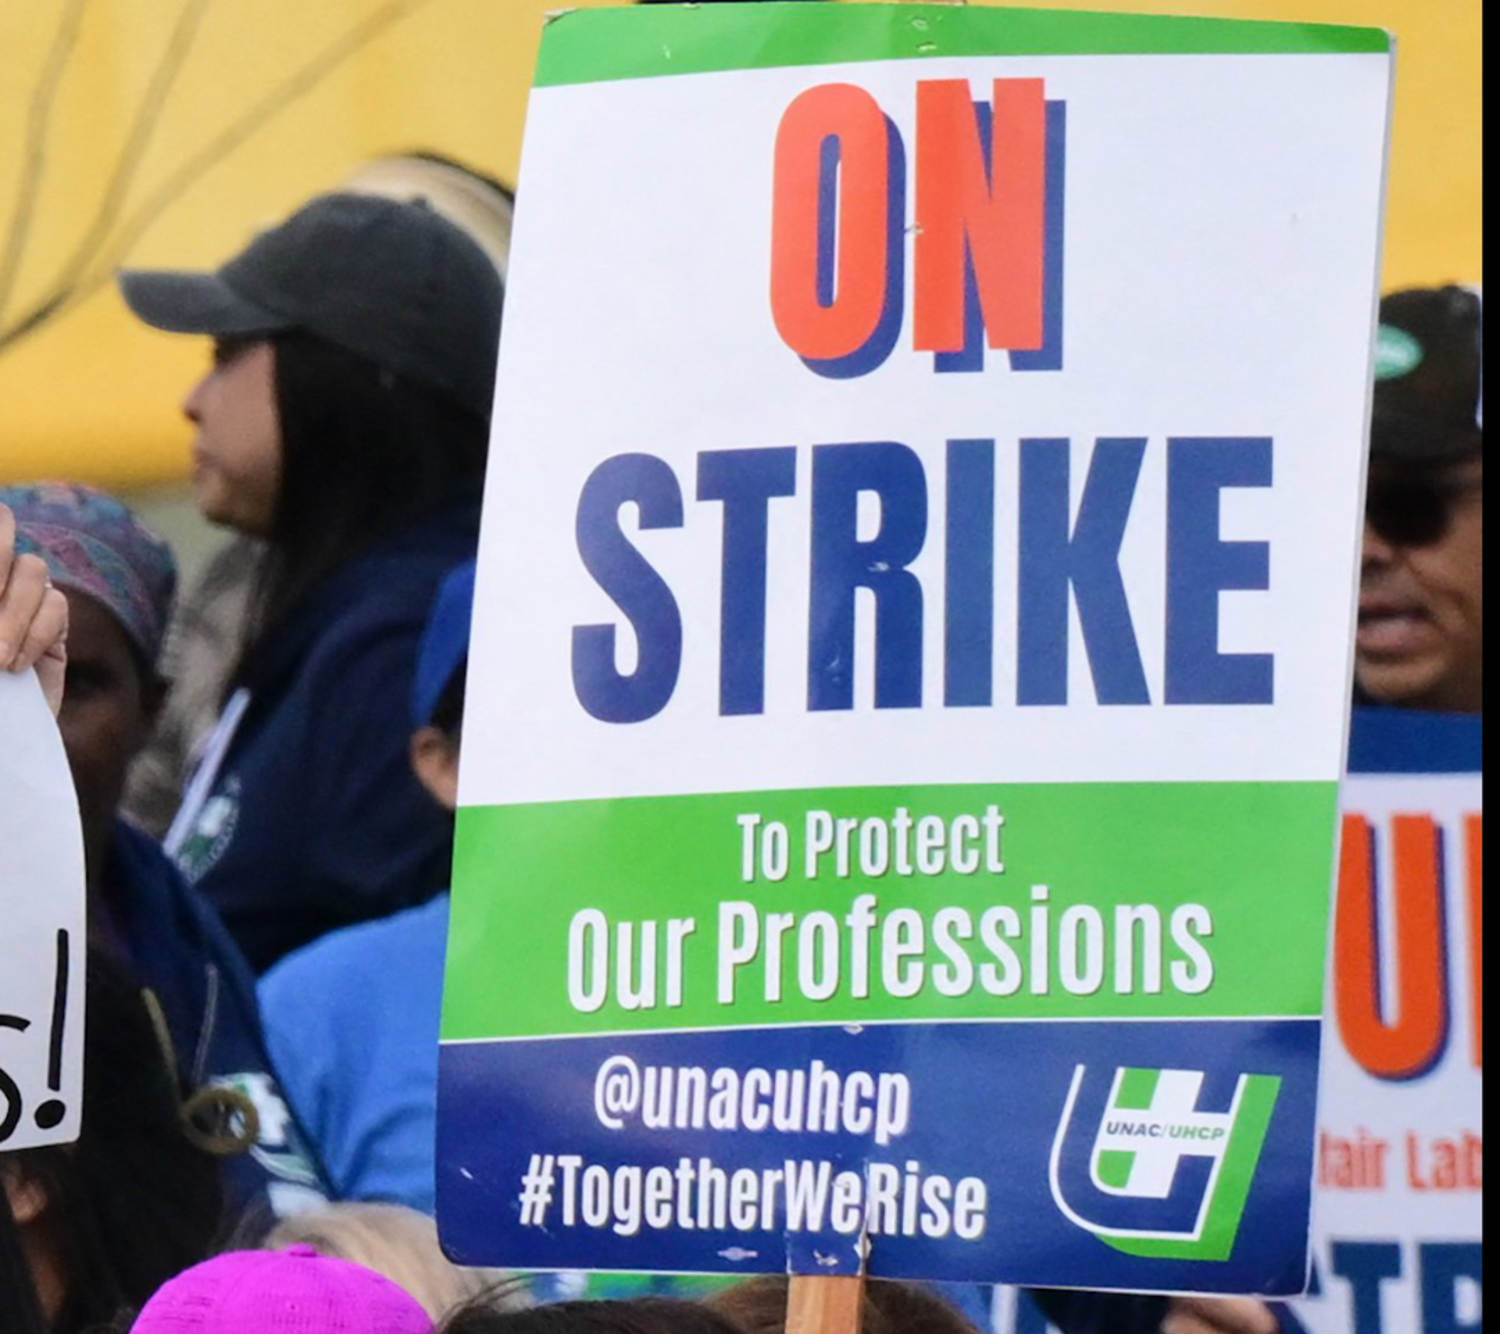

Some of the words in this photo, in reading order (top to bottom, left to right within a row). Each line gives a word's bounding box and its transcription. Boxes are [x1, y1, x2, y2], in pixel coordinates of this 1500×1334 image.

[770, 77, 1066, 380] ON
[570, 436, 1274, 724] STRIKE
[737, 813, 789, 882] To
[805, 805, 1005, 879] Protect
[567, 907, 695, 1013] Our
[717, 884, 1215, 1004] Professions
[1333, 812, 1482, 1082] U
[594, 1055, 911, 1146] @unacuhcp
[1106, 1121, 1225, 1140] UNAC/UHCP
[518, 1154, 988, 1240] #TogetherWeRise
